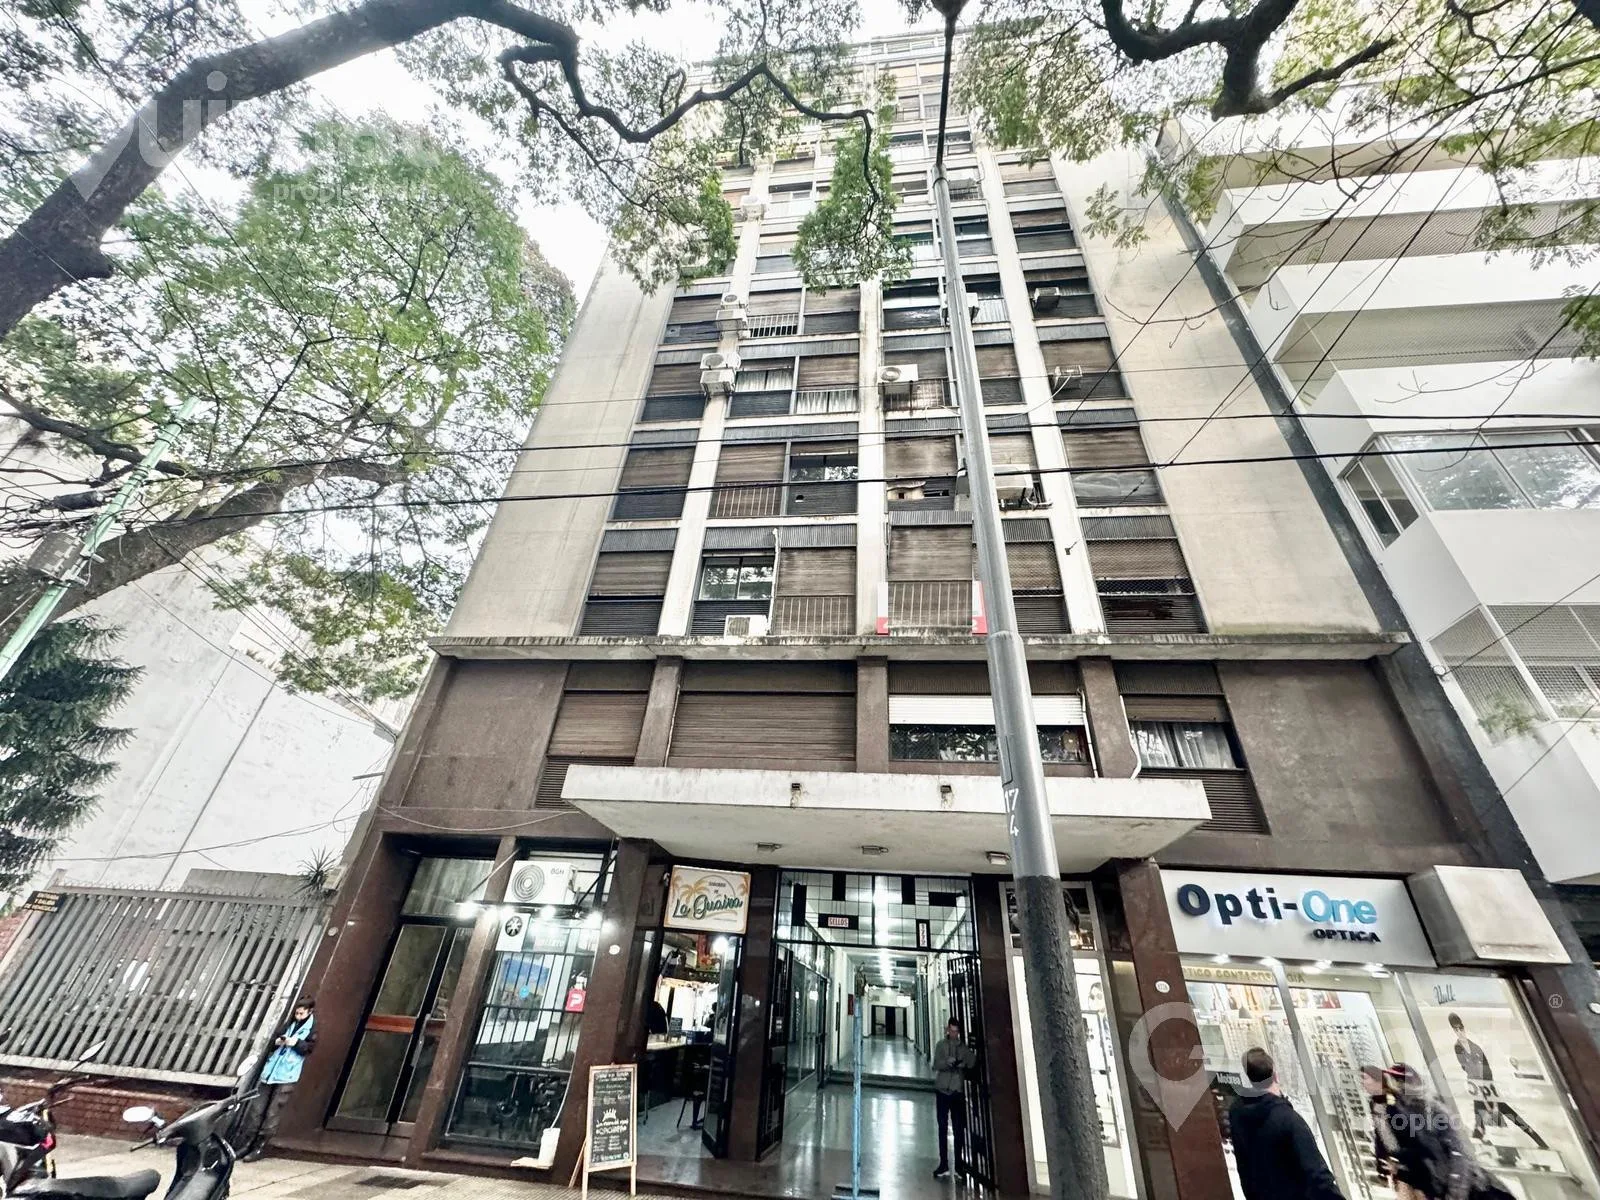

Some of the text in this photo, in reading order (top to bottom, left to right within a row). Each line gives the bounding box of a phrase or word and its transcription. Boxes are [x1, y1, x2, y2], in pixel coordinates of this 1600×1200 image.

[673, 898, 691, 918] La
[1177, 883, 1377, 925] Opti-One
[1312, 928, 1382, 943] OPTICA
